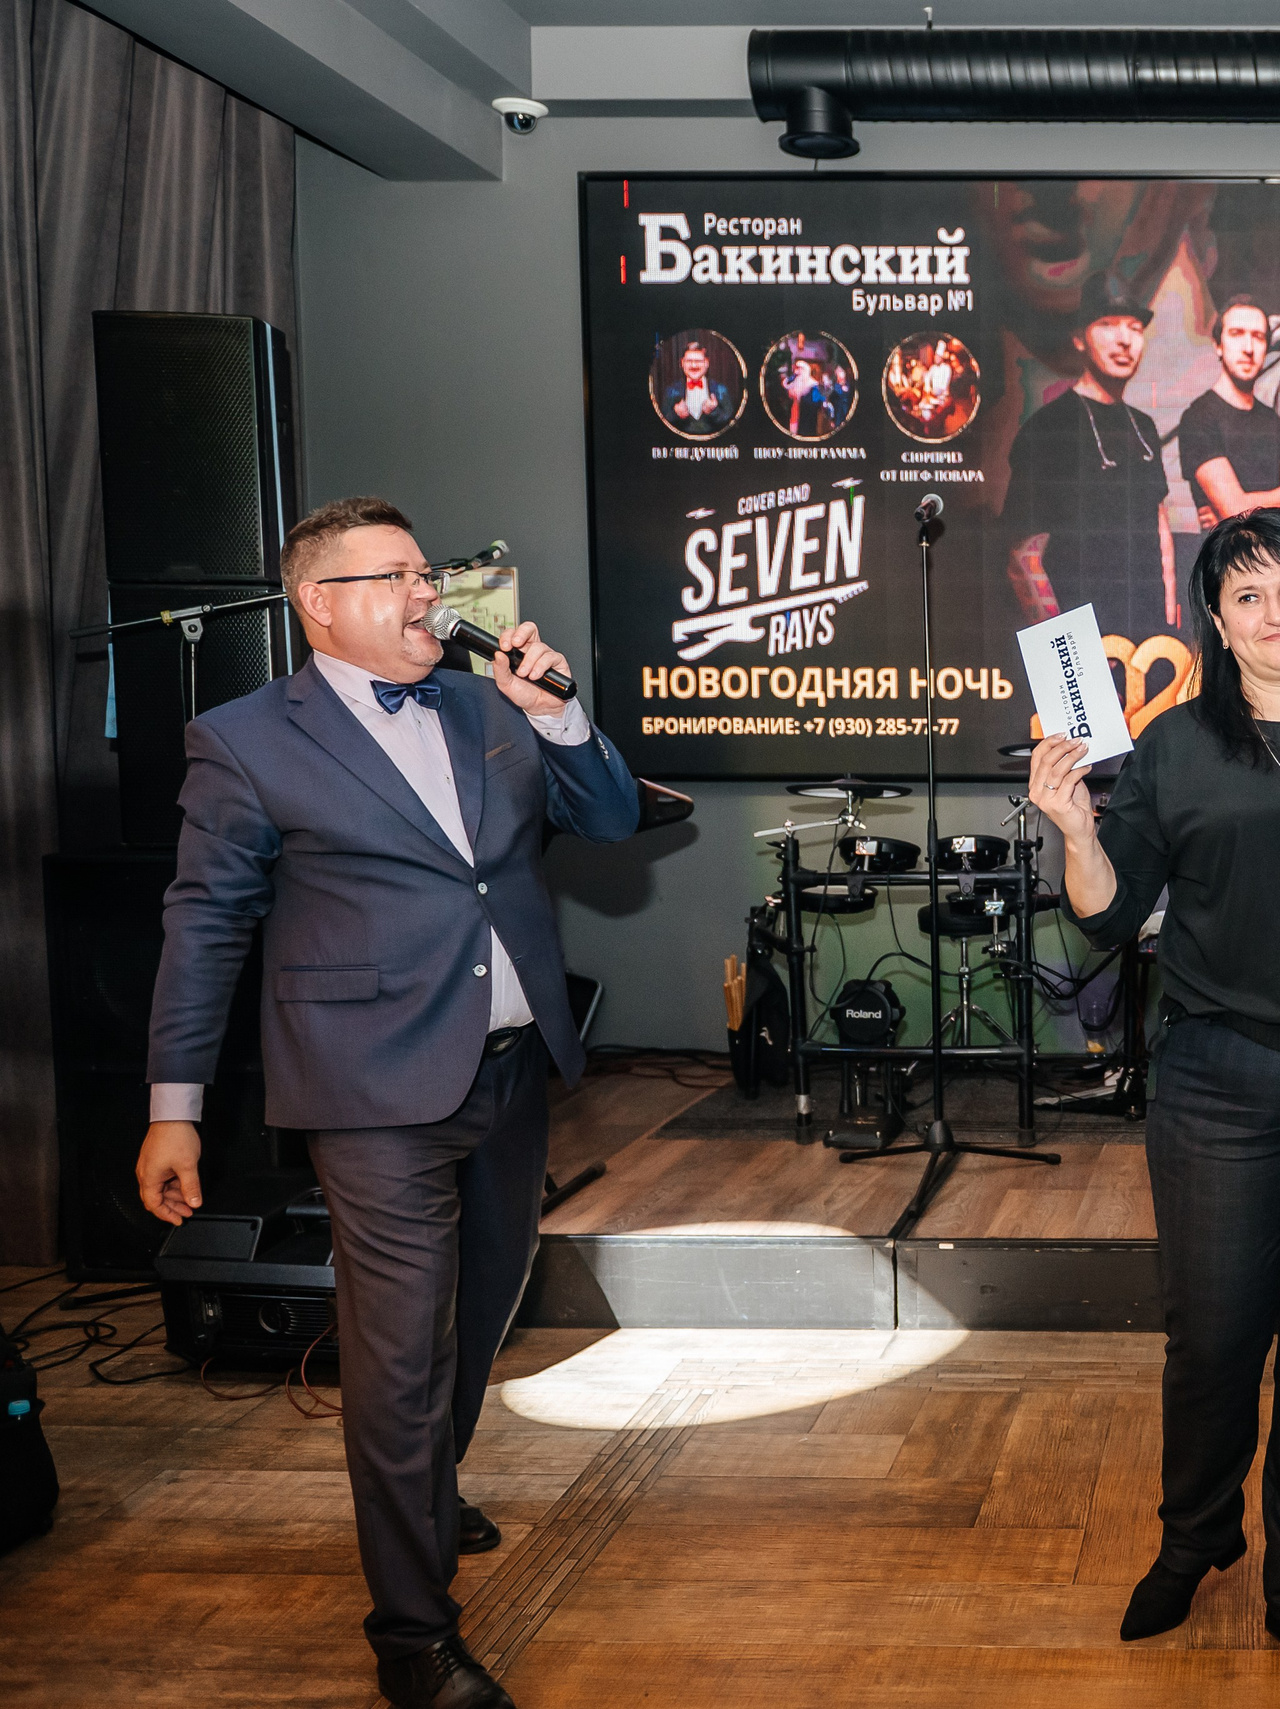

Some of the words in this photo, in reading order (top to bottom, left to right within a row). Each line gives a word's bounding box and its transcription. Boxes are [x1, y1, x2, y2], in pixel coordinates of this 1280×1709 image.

[703, 212, 802, 240] Ресторан
[638, 212, 970, 285] Бакинский
[852, 288, 943, 316] Бульвар
[880, 469, 897, 482] ОТ
[737, 490, 776, 515] COVER
[777, 482, 811, 507] BAND
[681, 495, 865, 613] SEVEN
[767, 603, 836, 657] RAYS
[642, 666, 899, 708] НОВОГОДНЯЯ
[909, 666, 1014, 701] НОЧЬ
[1050, 634, 1093, 739] Бакинский
[1059, 684, 1074, 726] Ресторан
[641, 716, 801, 736] БРОНИРОВАНИЕ:
[803, 717, 826, 735] +7
[828, 717, 873, 738] (930)
[846, 1009, 882, 1019] Roland
